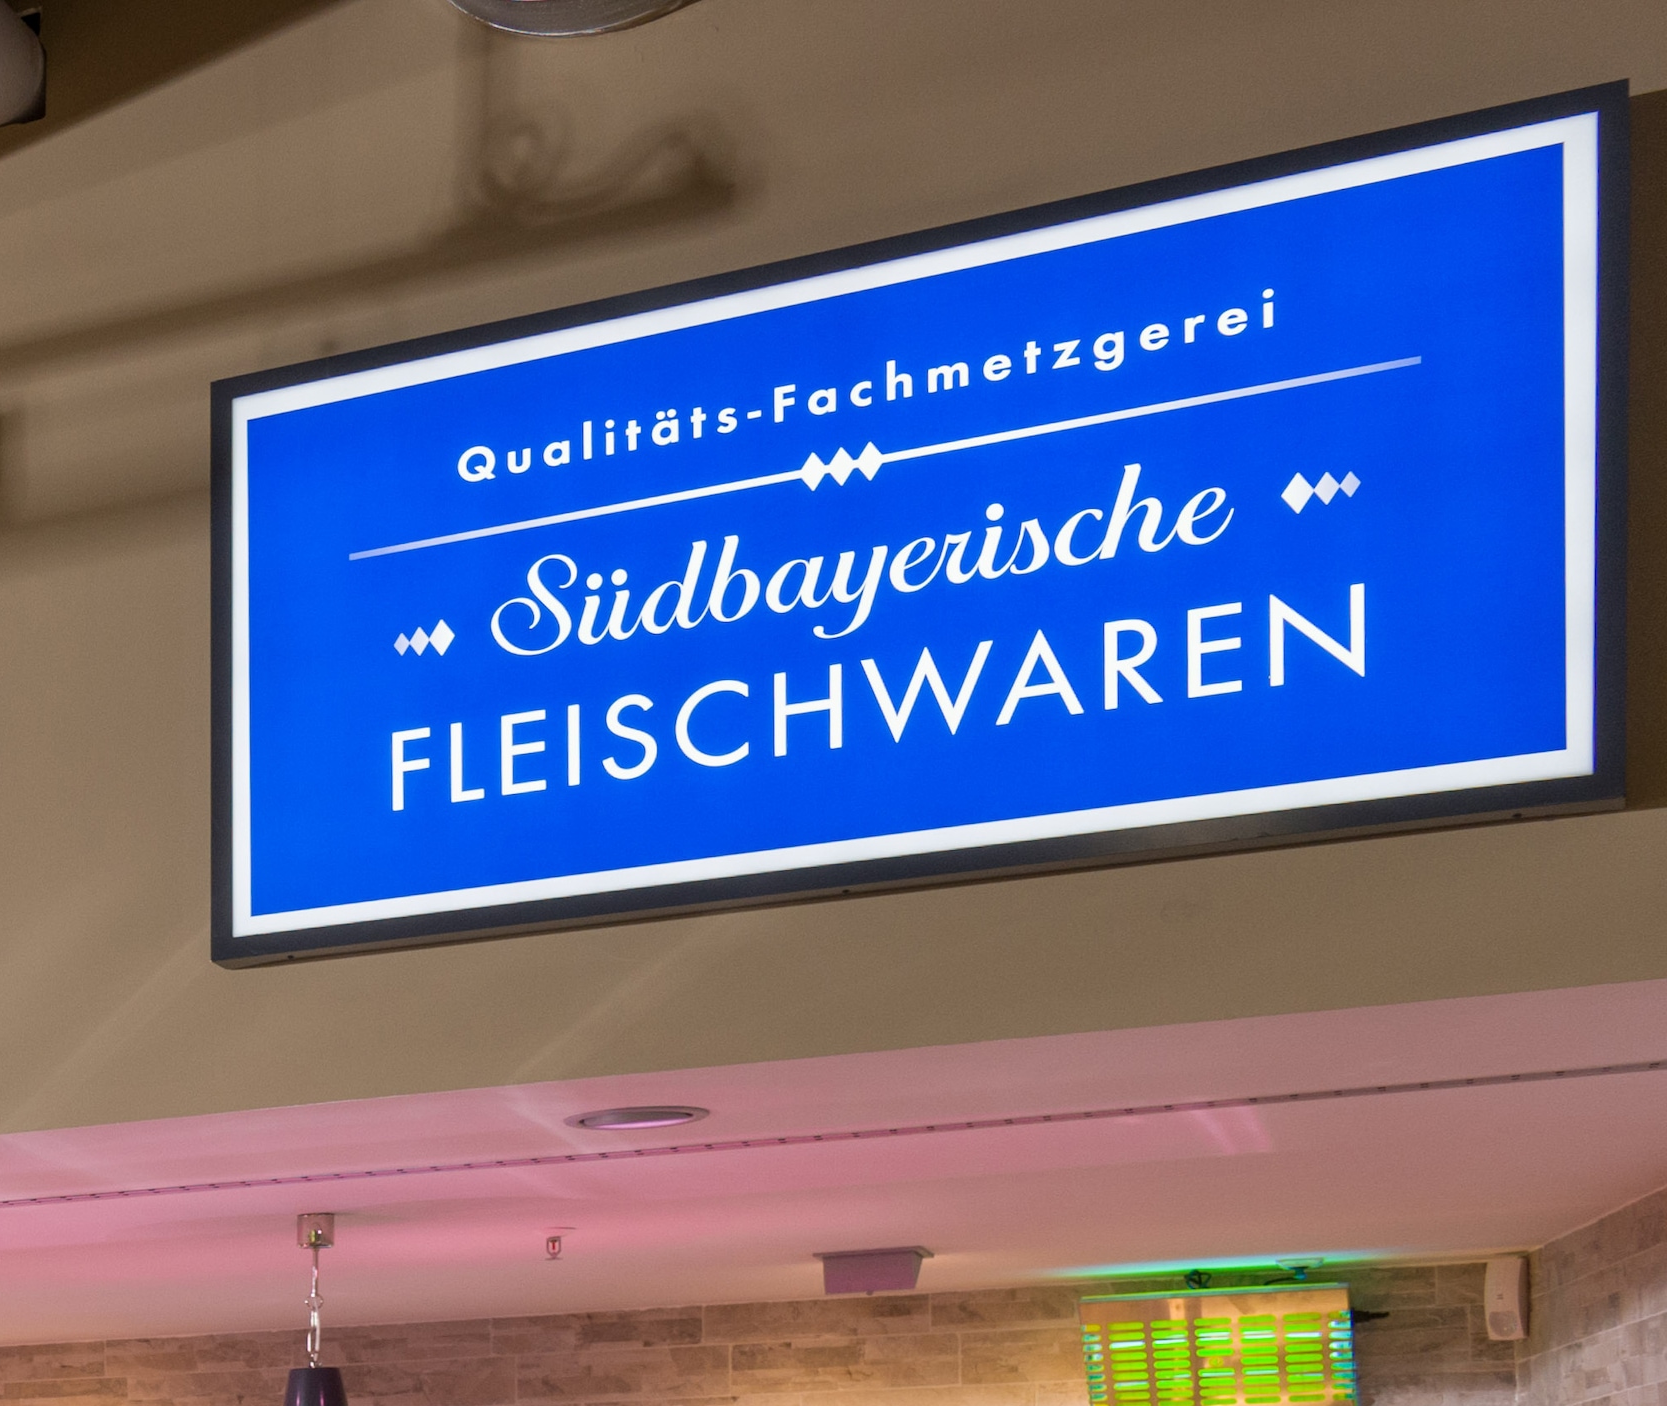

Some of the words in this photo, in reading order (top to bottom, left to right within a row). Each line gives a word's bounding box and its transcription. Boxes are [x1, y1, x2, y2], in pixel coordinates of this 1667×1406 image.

[456, 287, 1278, 484] Qualitäts-Fachmetzgerei
[491, 462, 1236, 656] Südbayerische
[389, 582, 1368, 812] FLEISCHWAREN
